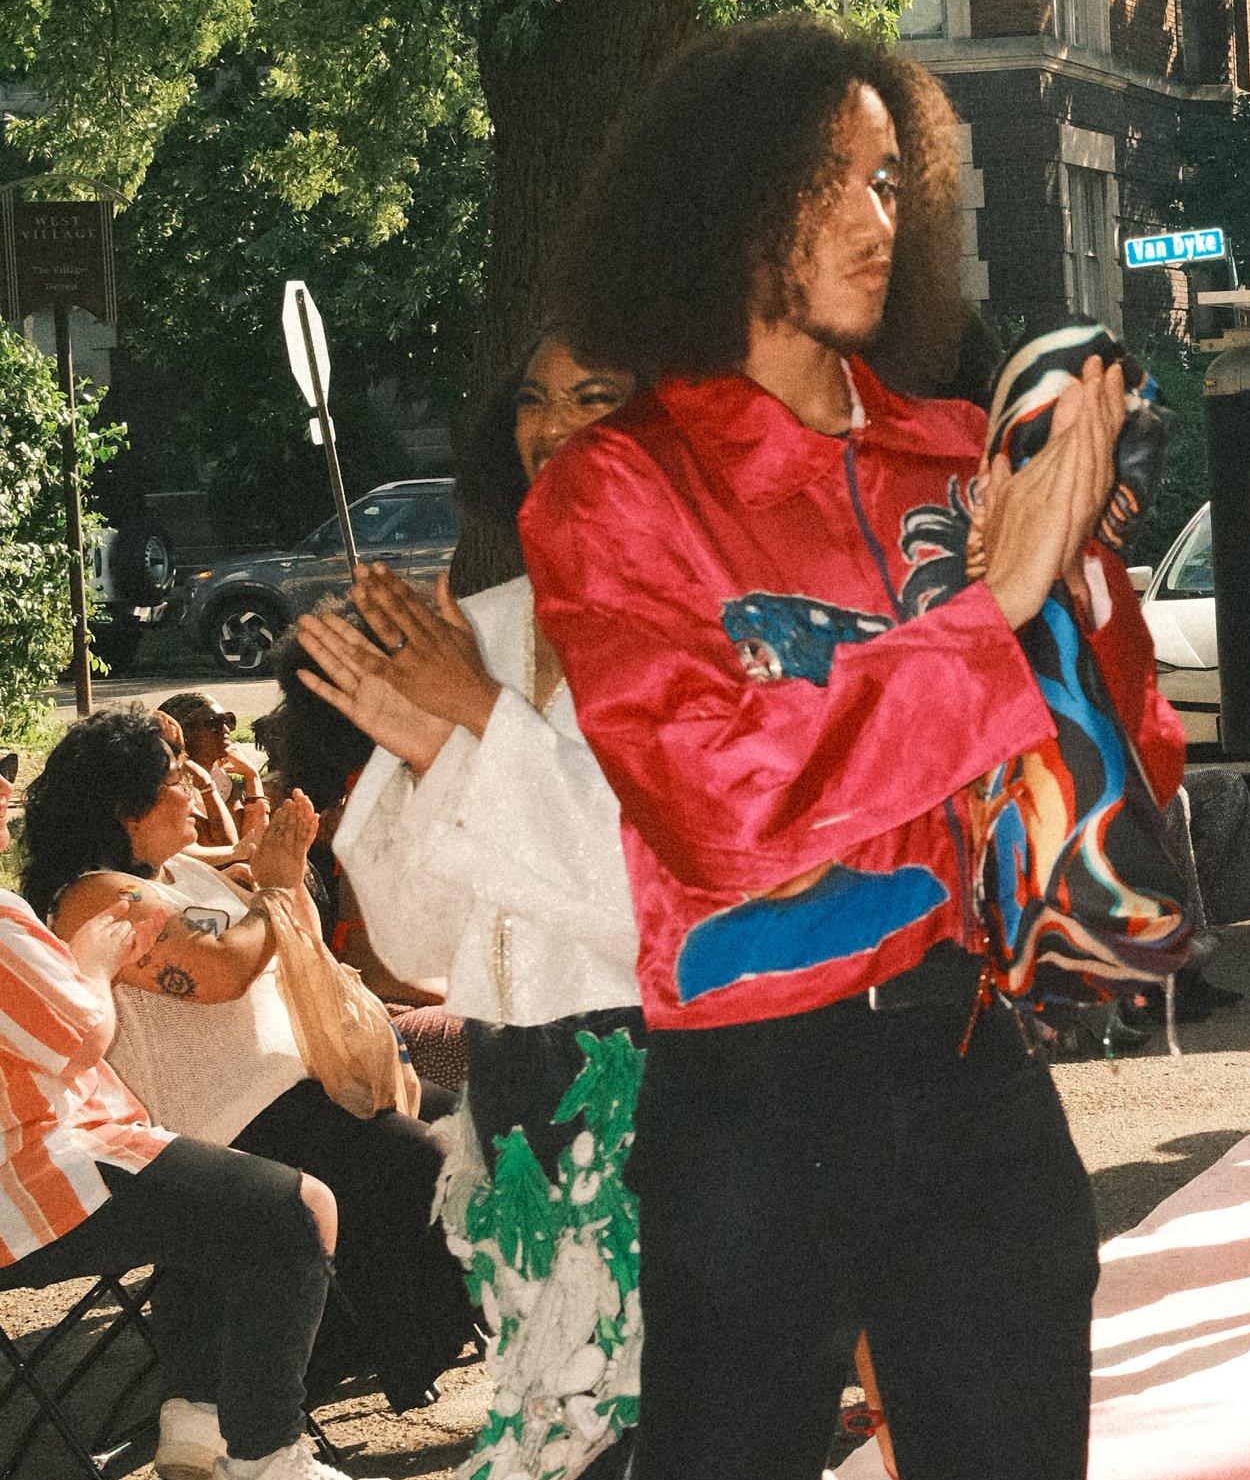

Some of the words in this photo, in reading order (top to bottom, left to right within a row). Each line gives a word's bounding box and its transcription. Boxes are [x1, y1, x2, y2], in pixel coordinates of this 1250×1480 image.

[35, 216, 80, 226] WEST
[21, 229, 98, 240] VILLAGE
[1133, 240, 1167, 261] Van
[1173, 234, 1217, 259] Dyke
